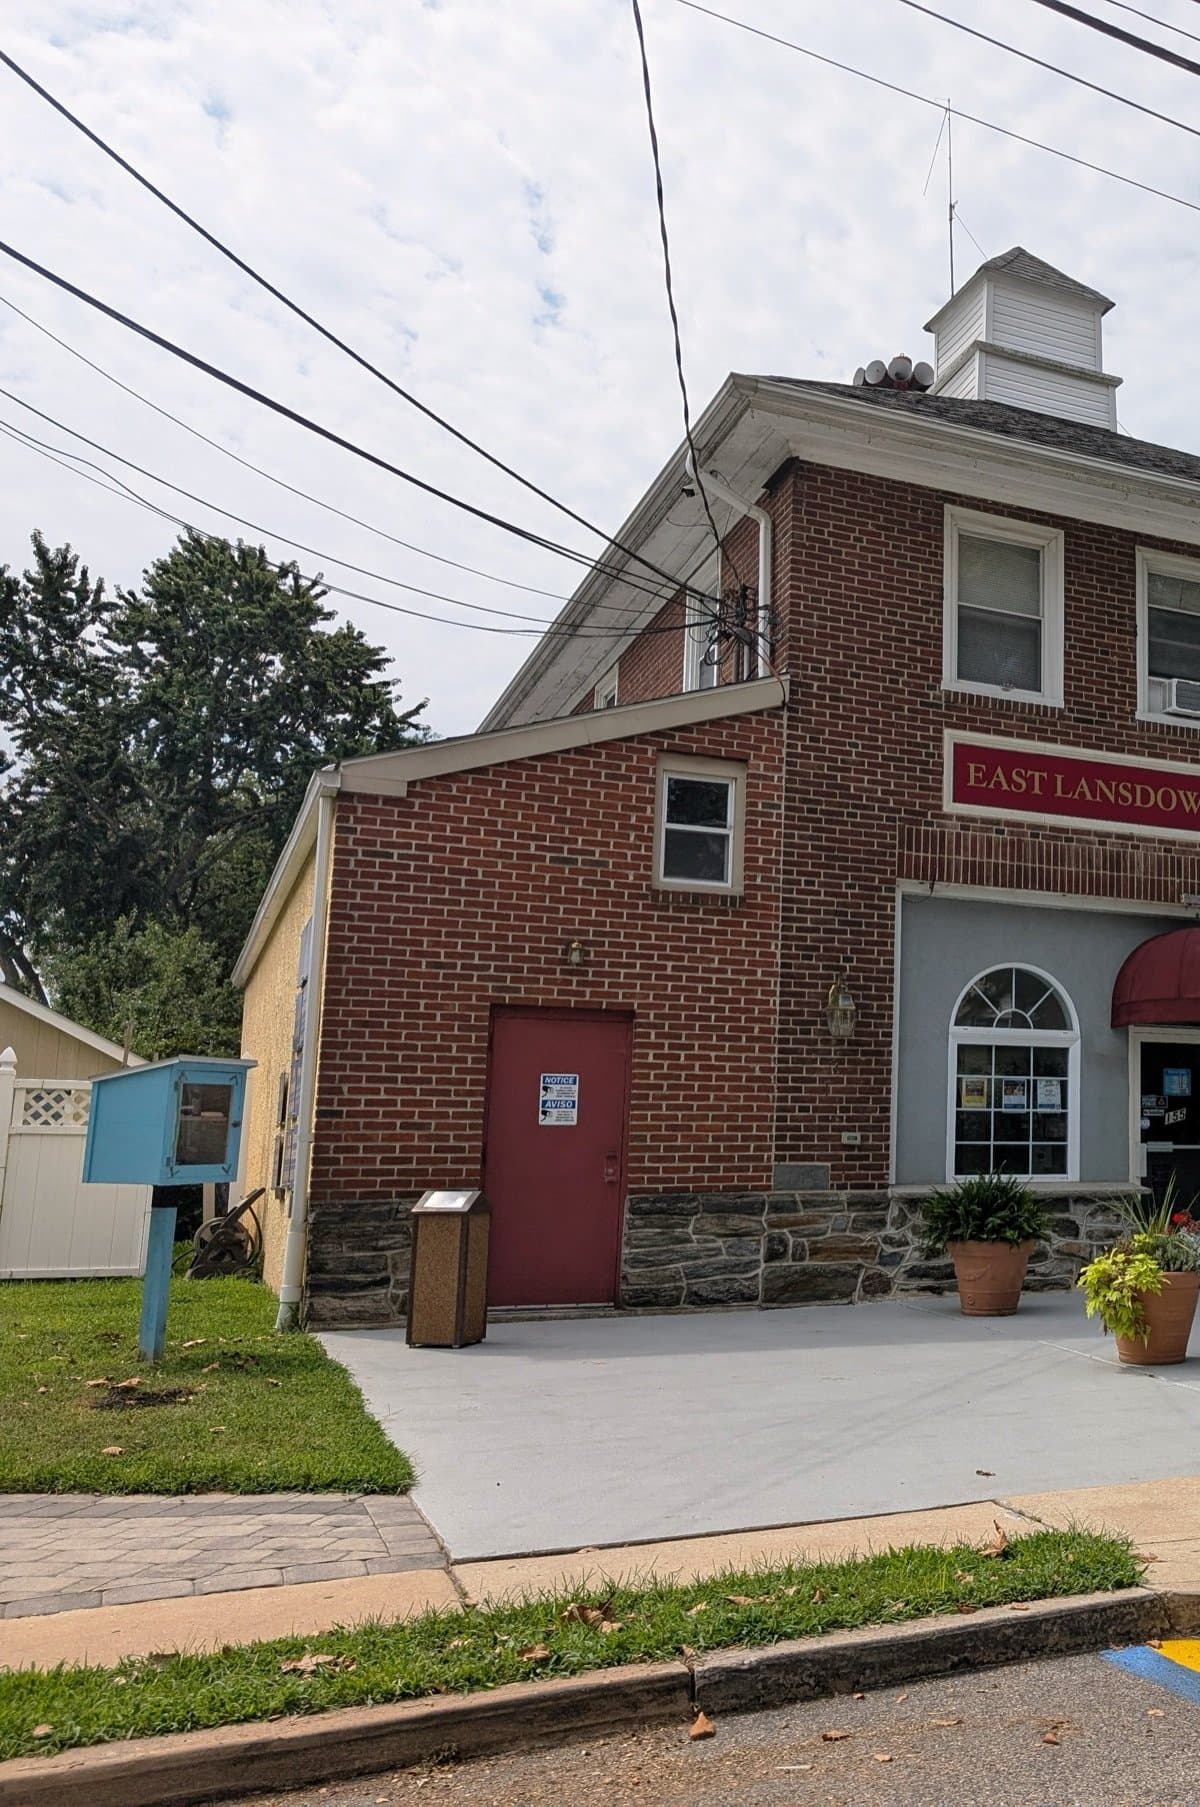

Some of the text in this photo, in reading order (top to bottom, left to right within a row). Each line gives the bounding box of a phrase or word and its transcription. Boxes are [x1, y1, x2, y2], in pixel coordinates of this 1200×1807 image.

[967, 763, 1047, 796] EAST
[544, 1076, 575, 1084] NOTICE
[1167, 1109, 1185, 1123] 155
